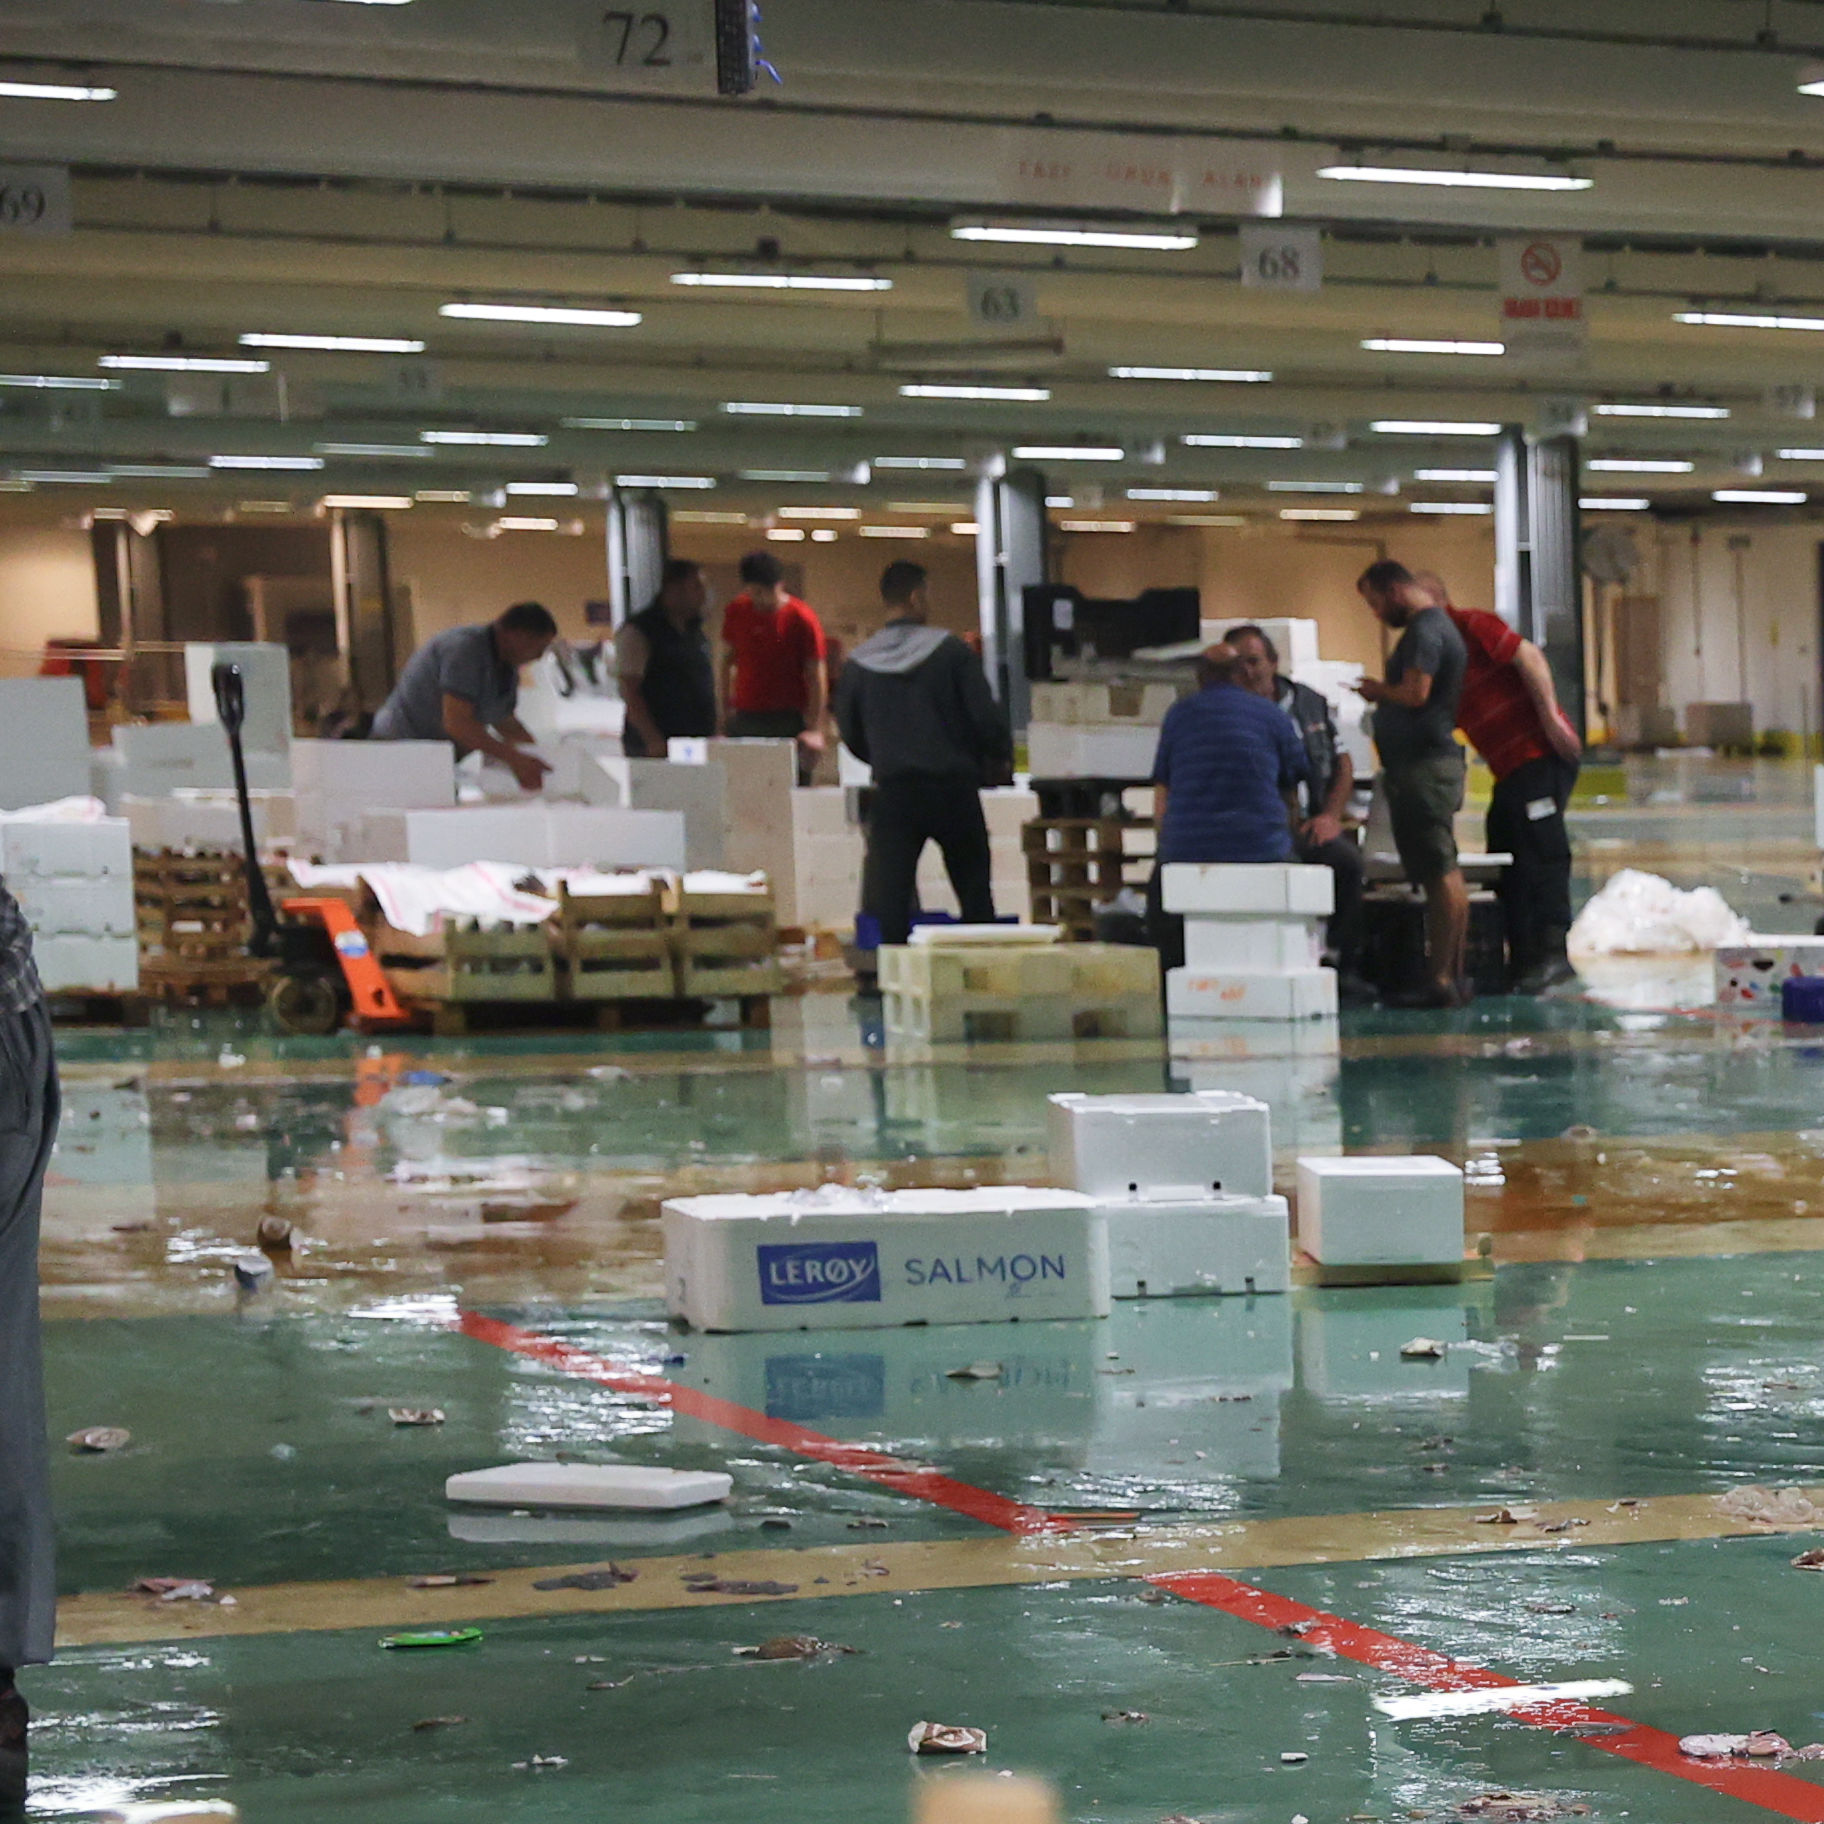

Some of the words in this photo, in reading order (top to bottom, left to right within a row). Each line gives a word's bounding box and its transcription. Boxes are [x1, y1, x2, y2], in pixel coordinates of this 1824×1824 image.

[603, 10, 672, 66] 72
[1258, 246, 1300, 279] 68
[769, 1257, 868, 1287] LERØY
[904, 1254, 1065, 1286] SALMON
